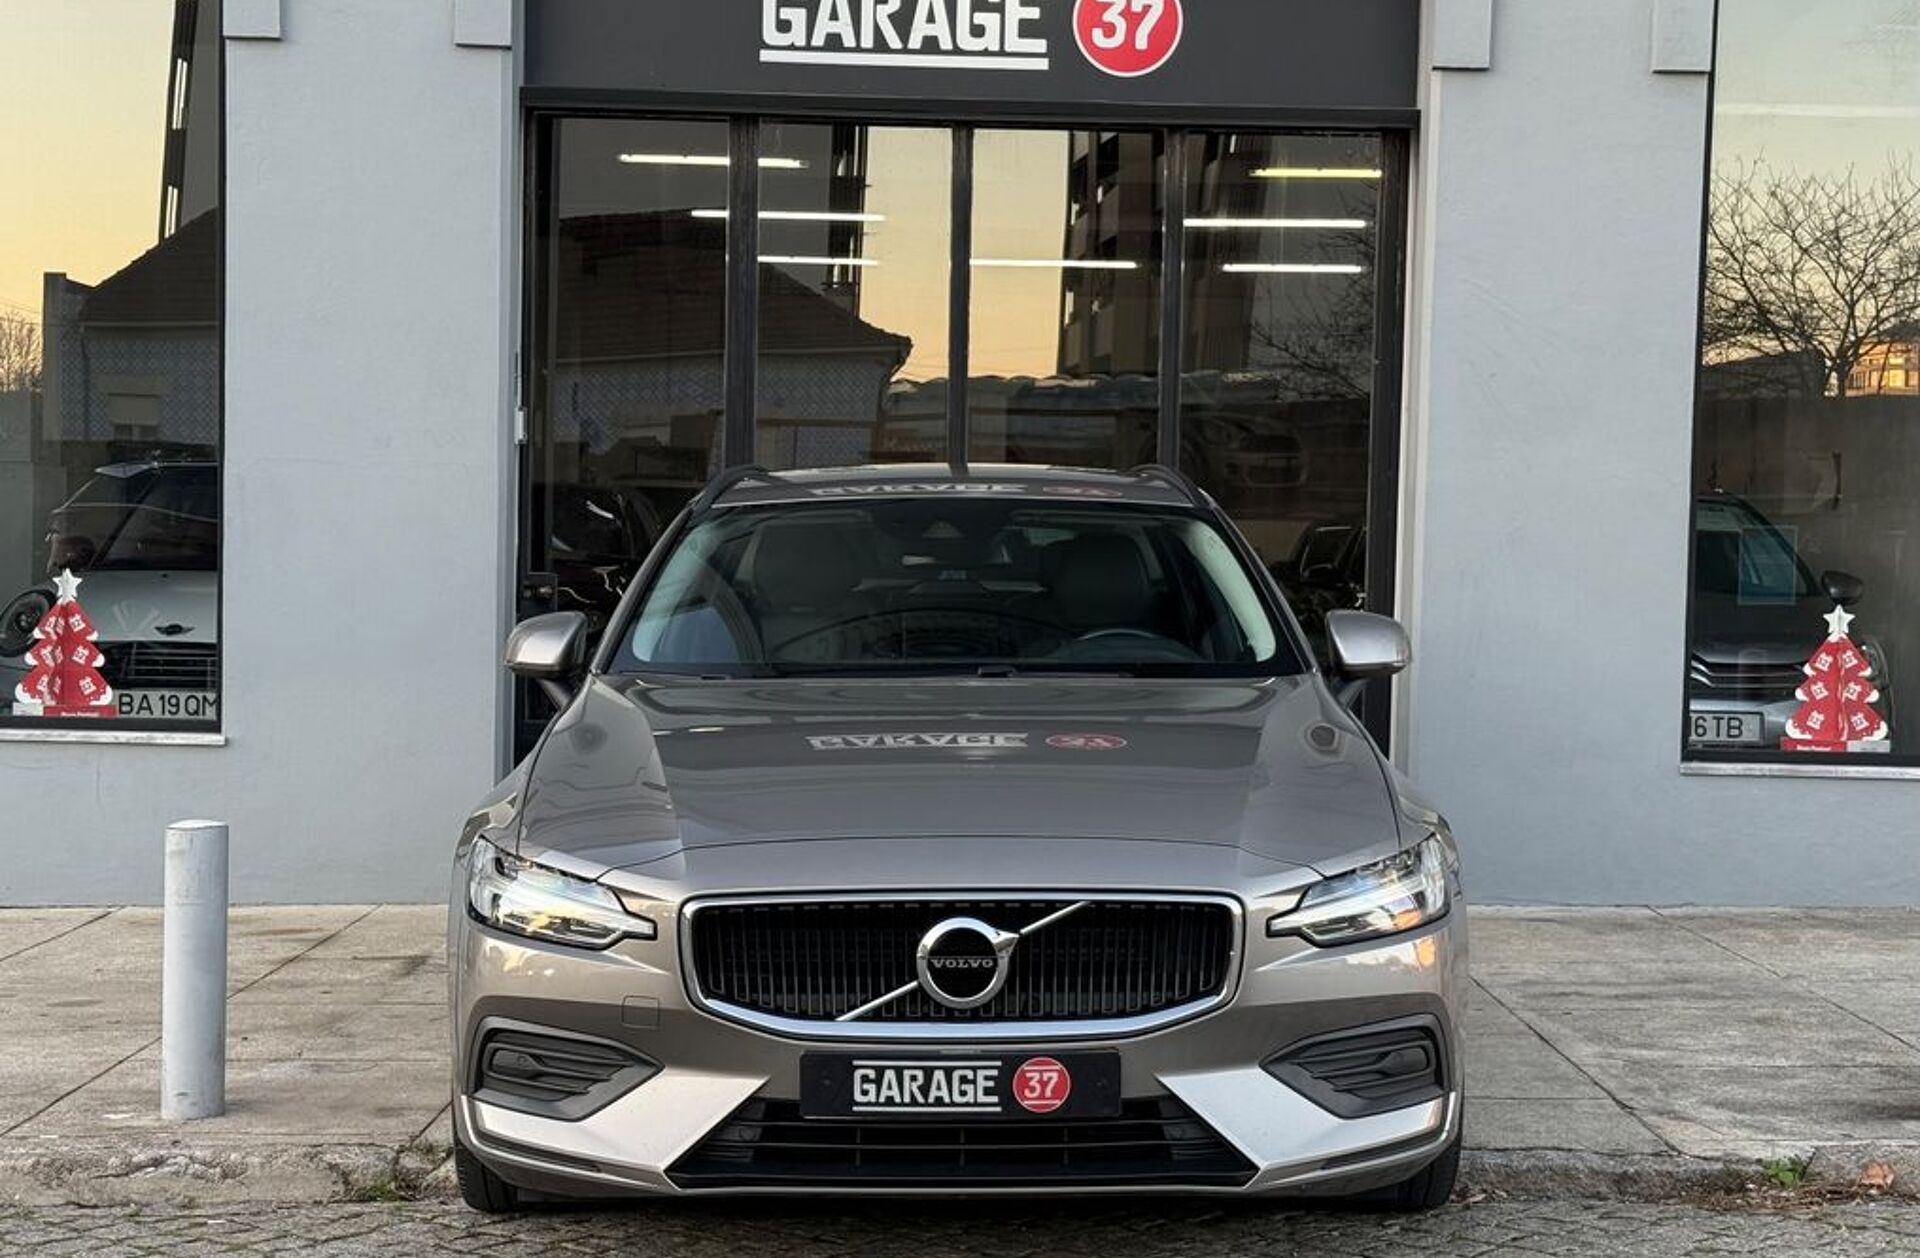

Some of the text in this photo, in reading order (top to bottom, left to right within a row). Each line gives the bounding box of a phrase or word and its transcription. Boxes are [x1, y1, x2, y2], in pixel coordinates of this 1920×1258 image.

[762, 0, 1164, 53] GARAGE 37
[118, 693, 153, 715] BA
[158, 694, 180, 716] 19
[1712, 716, 1743, 739] TB
[930, 959, 993, 968] VOLVO
[853, 1068, 1059, 1104] GARAGE 37
